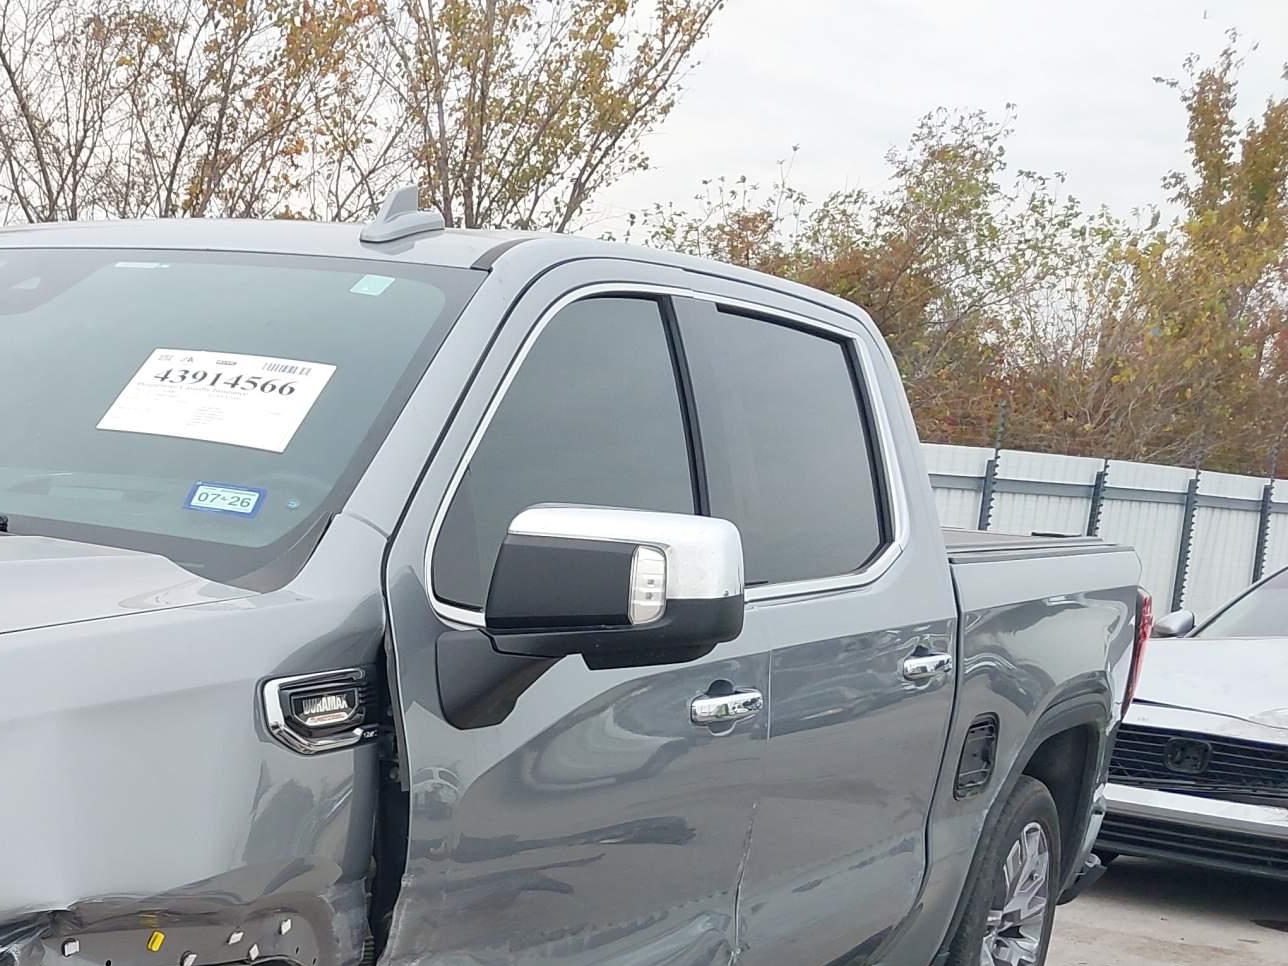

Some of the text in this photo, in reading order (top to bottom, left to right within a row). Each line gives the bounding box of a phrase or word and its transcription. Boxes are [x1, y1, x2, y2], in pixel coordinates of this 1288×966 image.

[154, 367, 299, 396] 43914566
[198, 492, 221, 502] 07
[227, 496, 252, 507] 26
